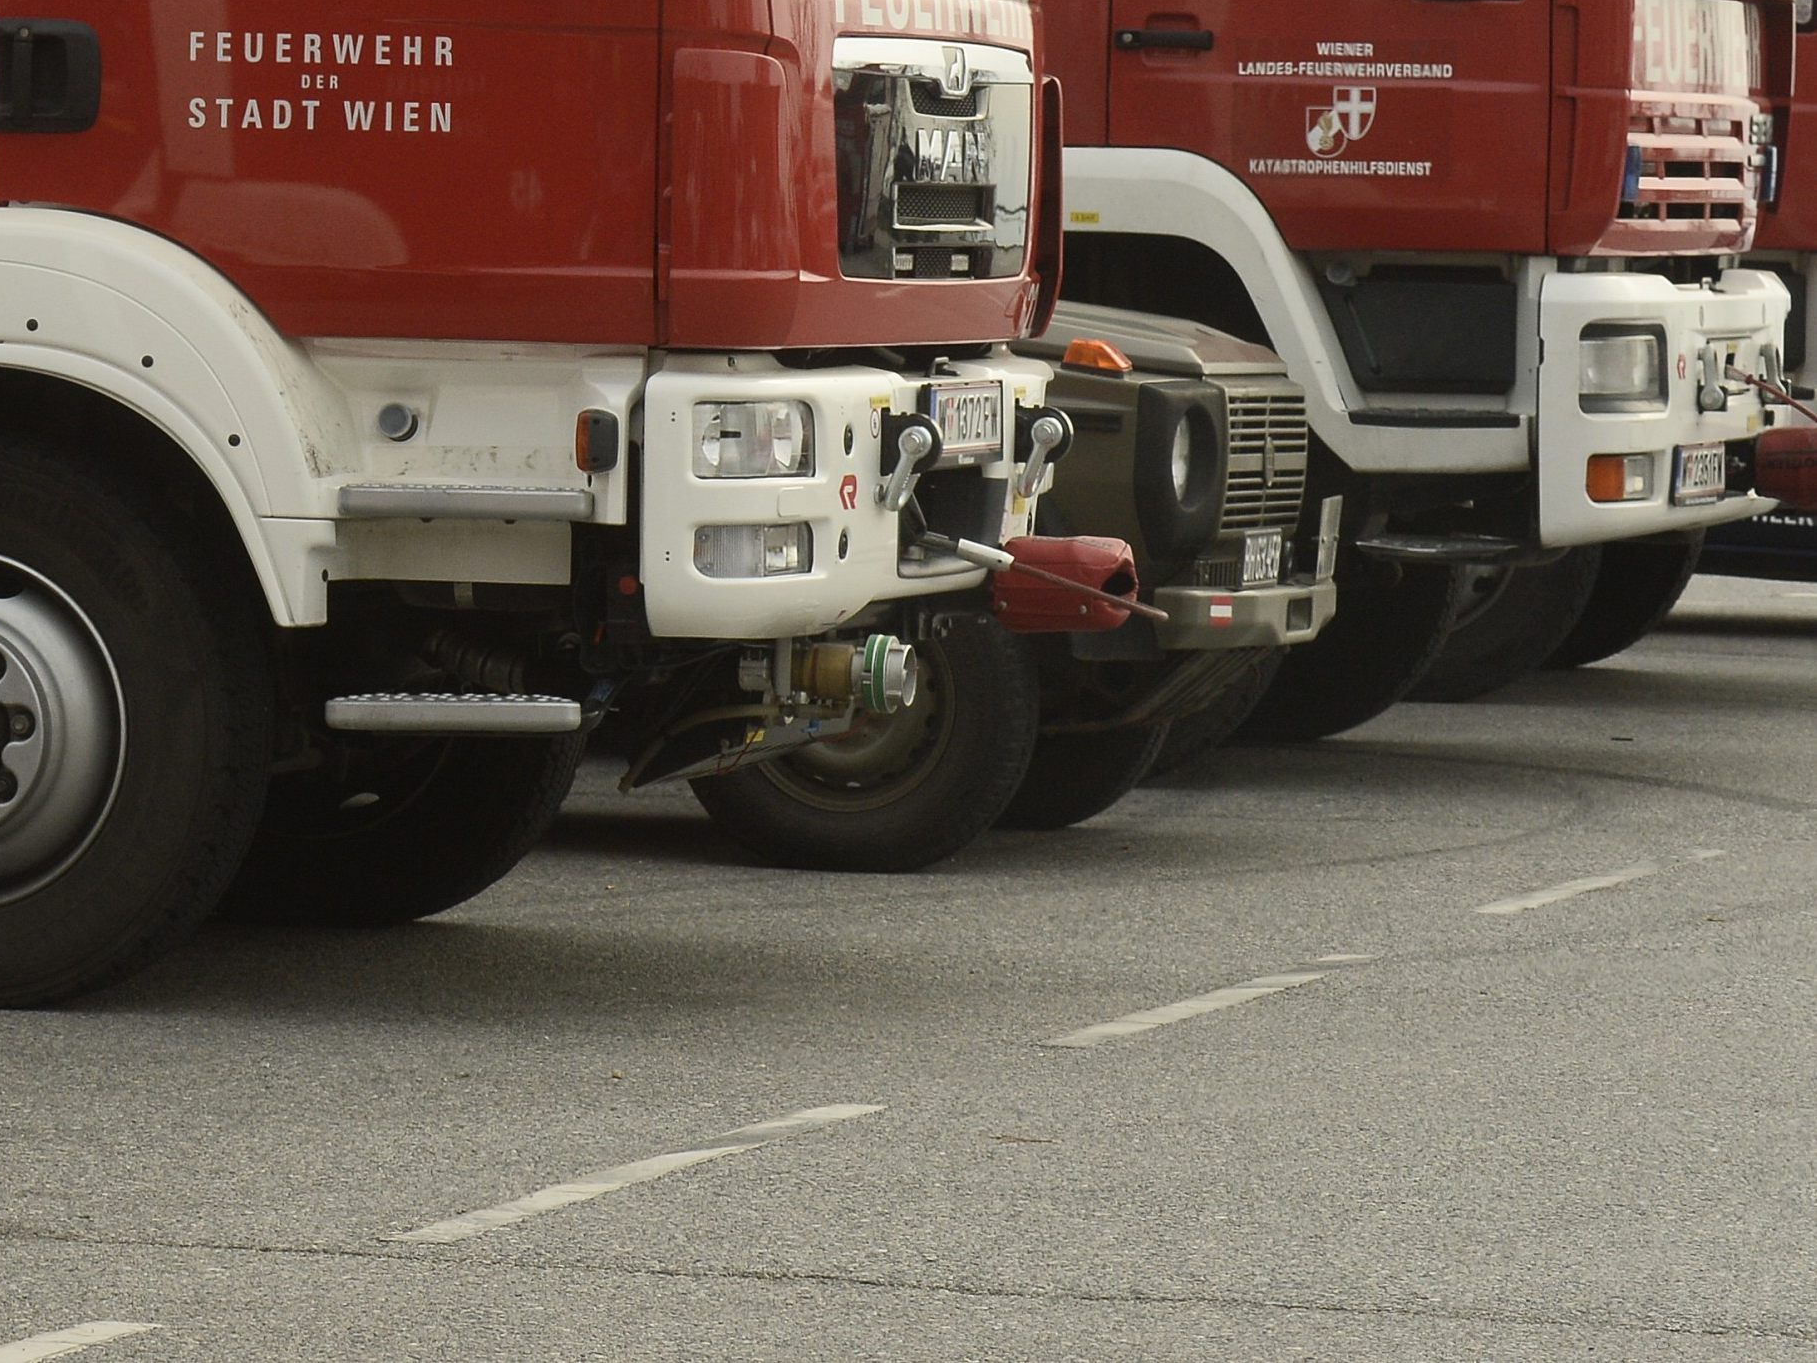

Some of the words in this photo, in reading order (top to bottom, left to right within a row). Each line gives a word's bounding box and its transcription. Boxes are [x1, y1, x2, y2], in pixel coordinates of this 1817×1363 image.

[189, 31, 454, 67] FEUERWEHR
[1316, 41, 1374, 57] WIENER
[1238, 61, 1453, 79] LANDES-FEUERWEHRVERBAND
[301, 74, 339, 90] DER
[188, 97, 320, 130] STADT
[343, 101, 452, 133] WIEN
[915, 127, 985, 183] MAN
[1249, 158, 1432, 176] KATASTROPHENHILFSDIENST
